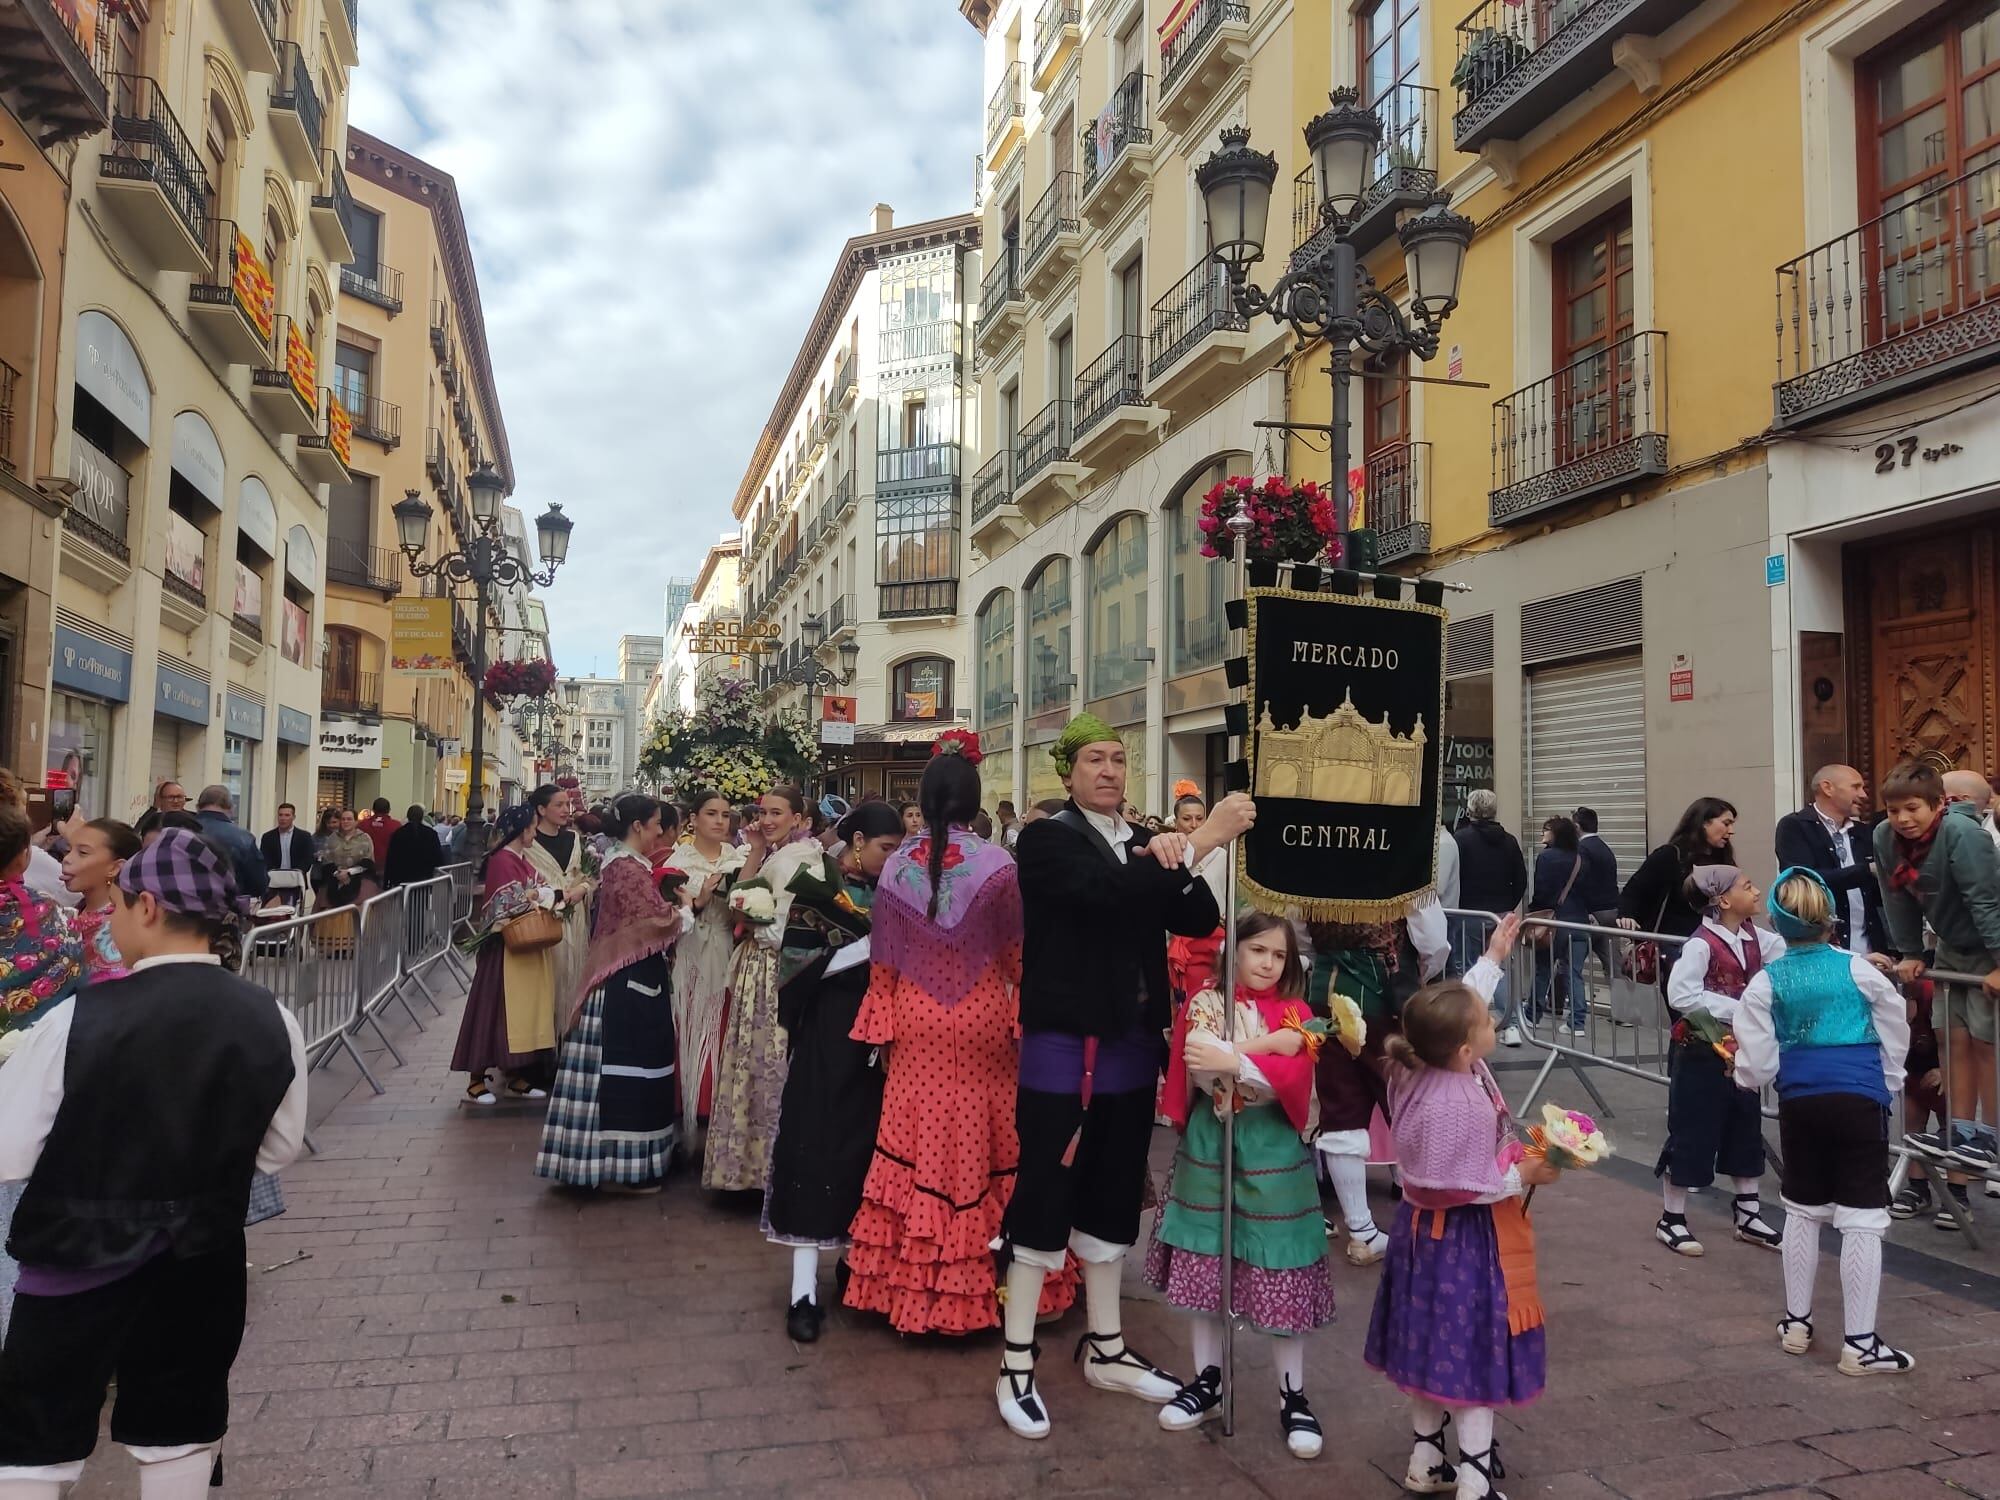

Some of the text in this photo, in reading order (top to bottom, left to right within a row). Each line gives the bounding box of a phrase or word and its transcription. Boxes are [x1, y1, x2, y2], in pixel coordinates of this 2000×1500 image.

[1875, 436, 1919, 474] 27
[78, 455, 114, 515] DIOR
[681, 621, 782, 637] MERCADO
[689, 638, 774, 654] CENTRAL
[1291, 640, 1399, 670] MERCADO
[1671, 672, 1692, 681] Alarma
[319, 731, 378, 748] ying tiger
[321, 746, 363, 755] copenhagen
[1455, 764, 1493, 780] PARA
[1281, 824, 1392, 851] CENTRAL
